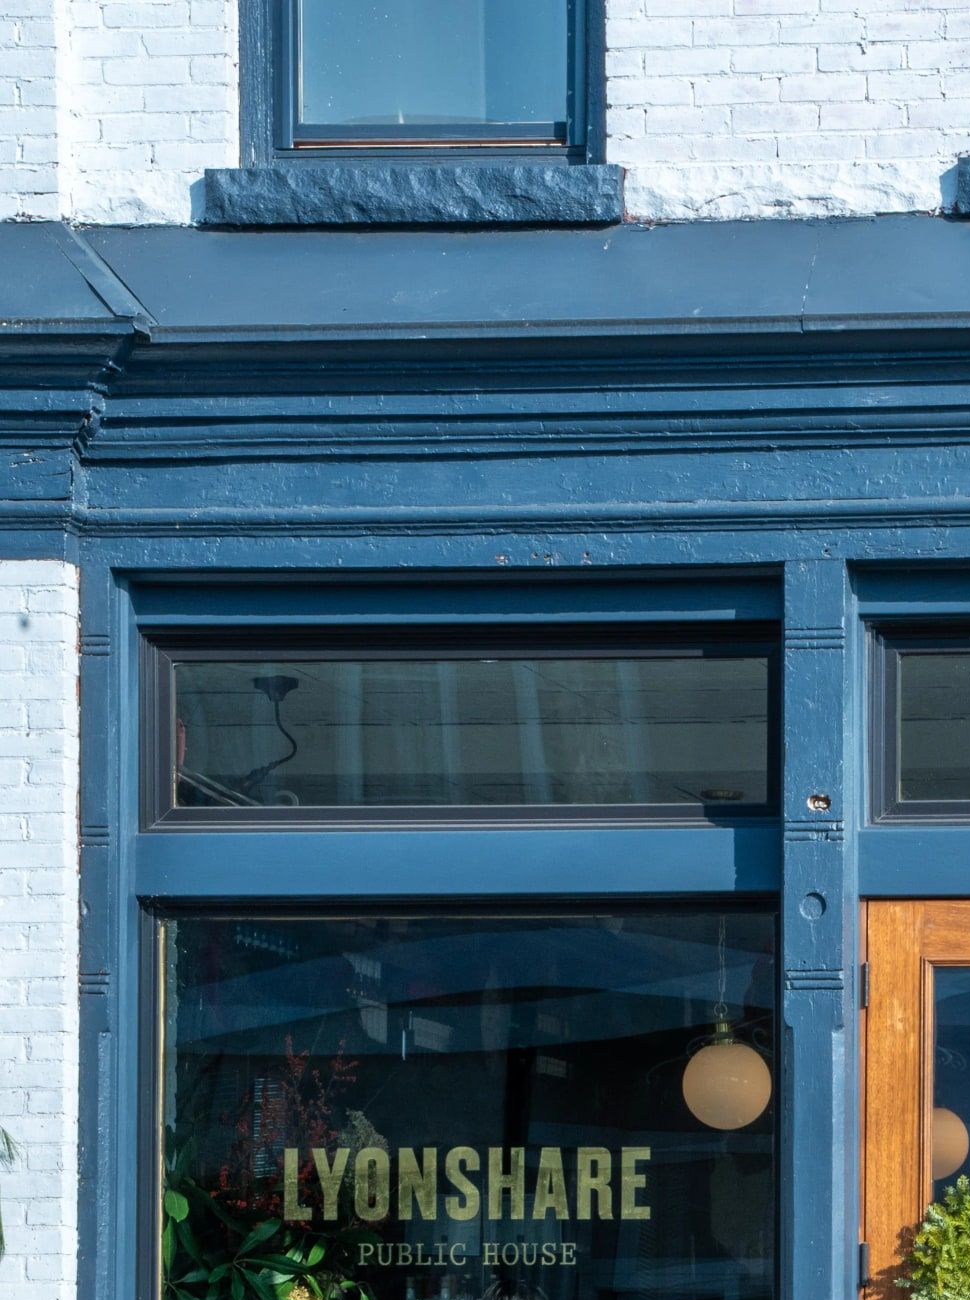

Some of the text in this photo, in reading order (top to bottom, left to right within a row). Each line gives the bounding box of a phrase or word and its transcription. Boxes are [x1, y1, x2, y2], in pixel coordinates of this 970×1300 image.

[283, 1146, 651, 1220] LYONSHARE
[358, 1243, 577, 1265] PUBLIC HOUSE
